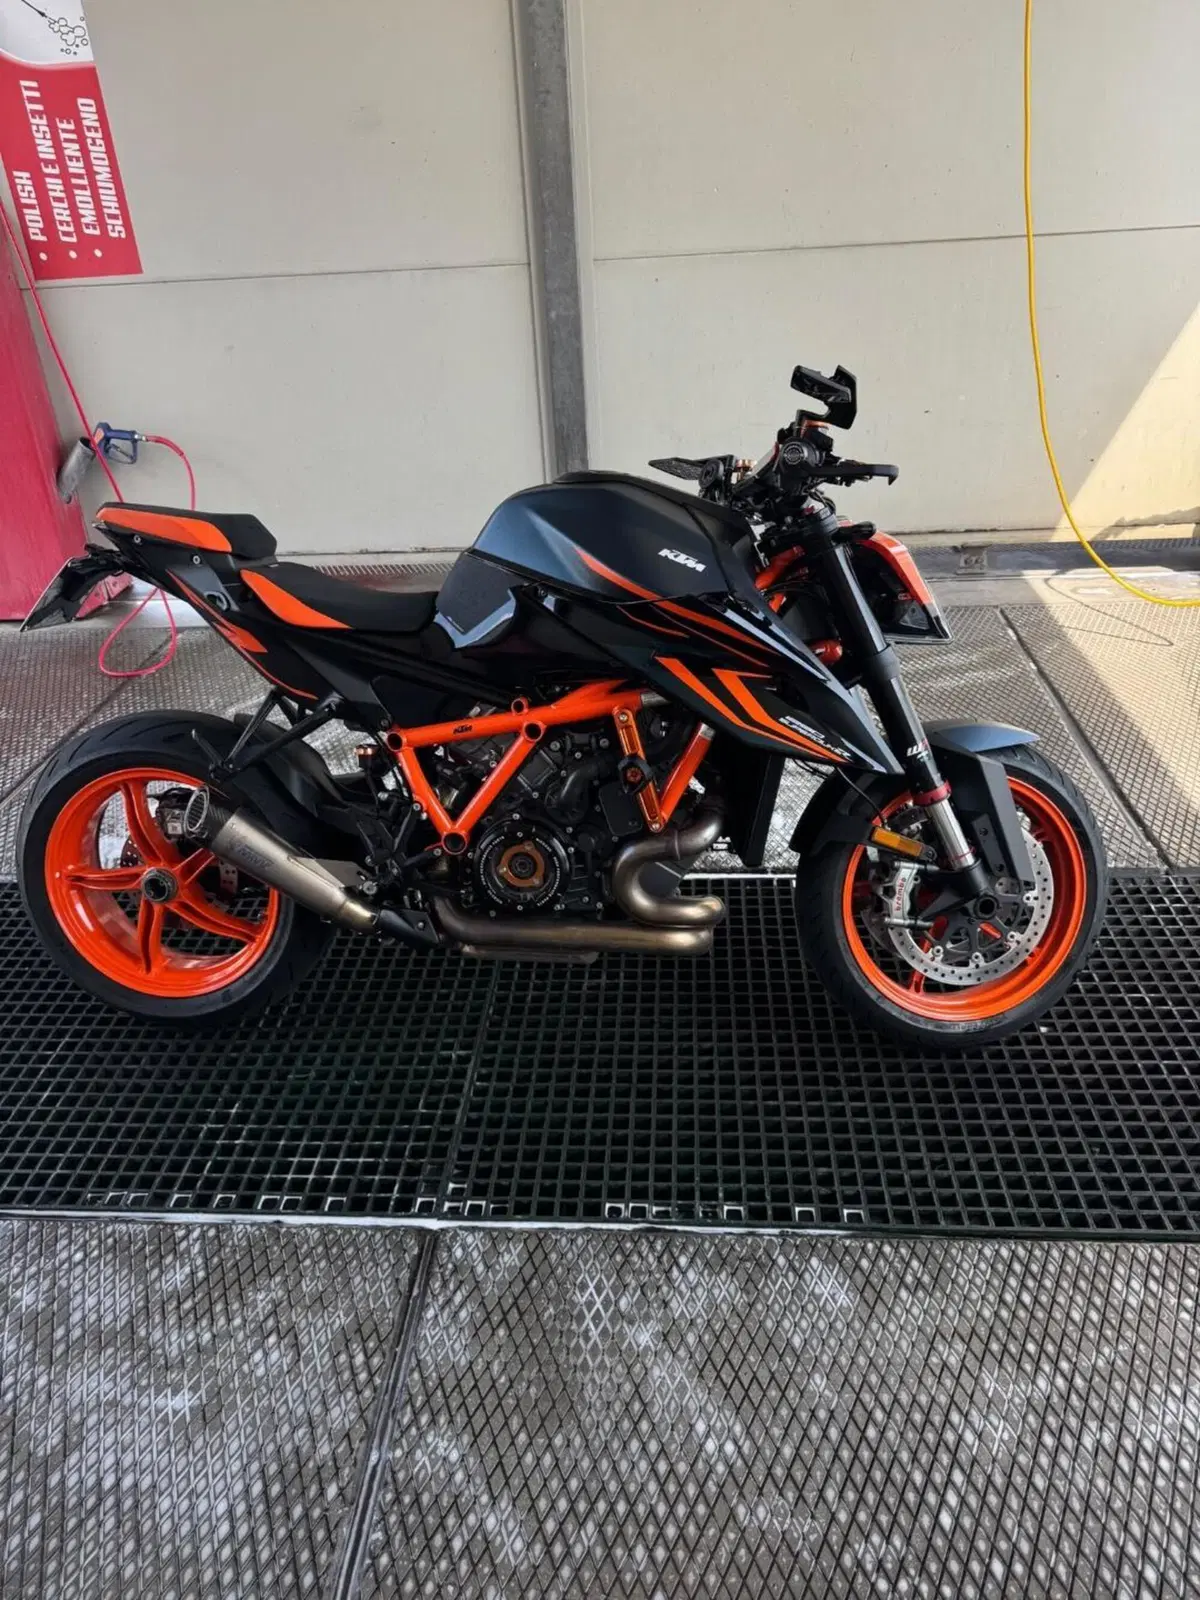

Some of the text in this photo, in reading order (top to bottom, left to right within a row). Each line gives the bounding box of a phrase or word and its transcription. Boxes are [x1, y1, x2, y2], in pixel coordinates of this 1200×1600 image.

[12, 171, 48, 242] POLISH
[19, 79, 78, 243] CERCHI E INSETTI
[56, 117, 101, 236] EMOLLIENTE
[77, 97, 126, 239] SCHIUMOGENO
[657, 548, 706, 572] KTM
